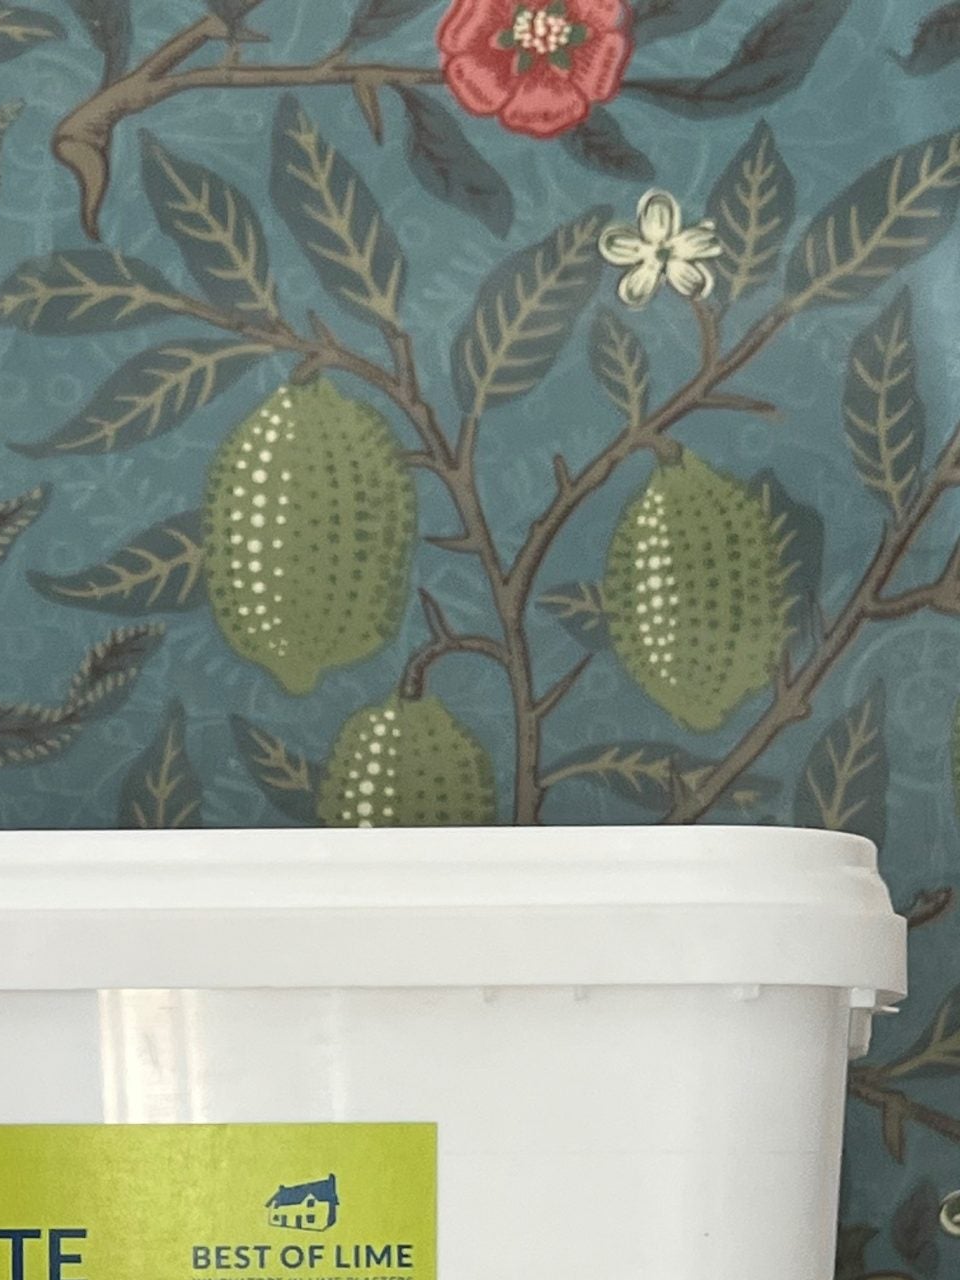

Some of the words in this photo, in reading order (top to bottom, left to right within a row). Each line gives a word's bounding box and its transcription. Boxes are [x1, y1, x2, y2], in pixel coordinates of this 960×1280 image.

[192, 1245, 272, 1270] BEST
[280, 1244, 325, 1269] OF
[335, 1244, 414, 1269] LIME
